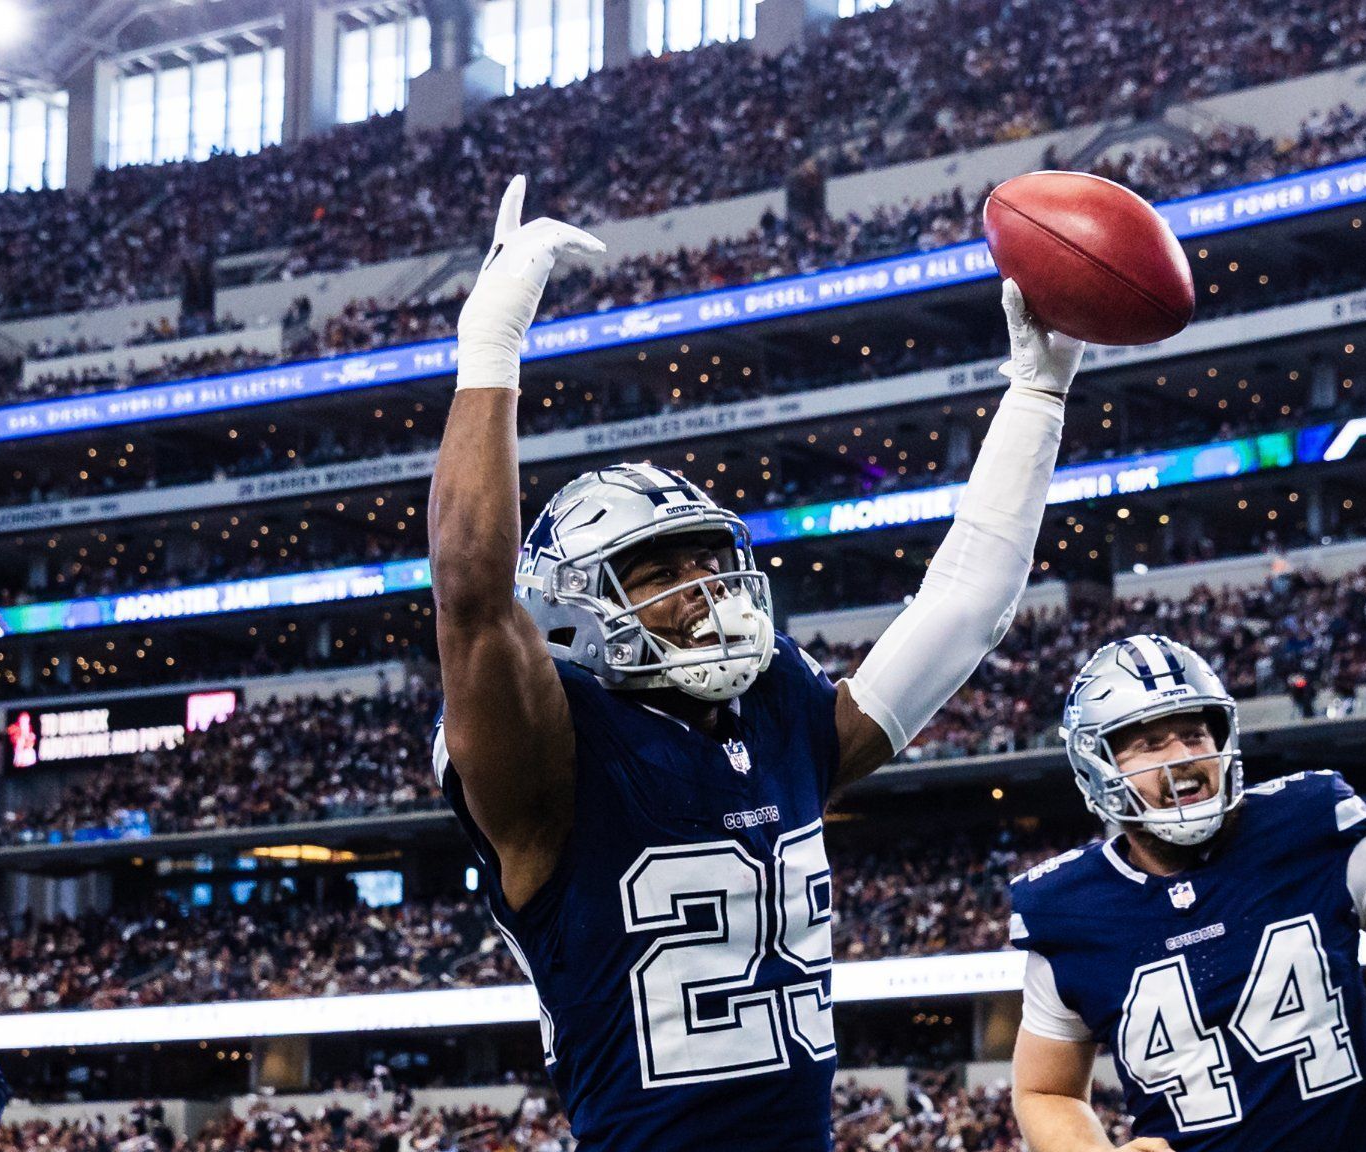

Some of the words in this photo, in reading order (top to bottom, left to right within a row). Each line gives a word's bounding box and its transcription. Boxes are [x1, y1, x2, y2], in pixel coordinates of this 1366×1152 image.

[1188, 200, 1228, 227] THE
[1233, 185, 1305, 216] POWER
[1310, 178, 1333, 201] IS
[829, 491, 952, 533] MONSTER
[723, 805, 781, 830] COWBOYS
[619, 817, 837, 1090] 29
[1117, 914, 1363, 1133] 44
